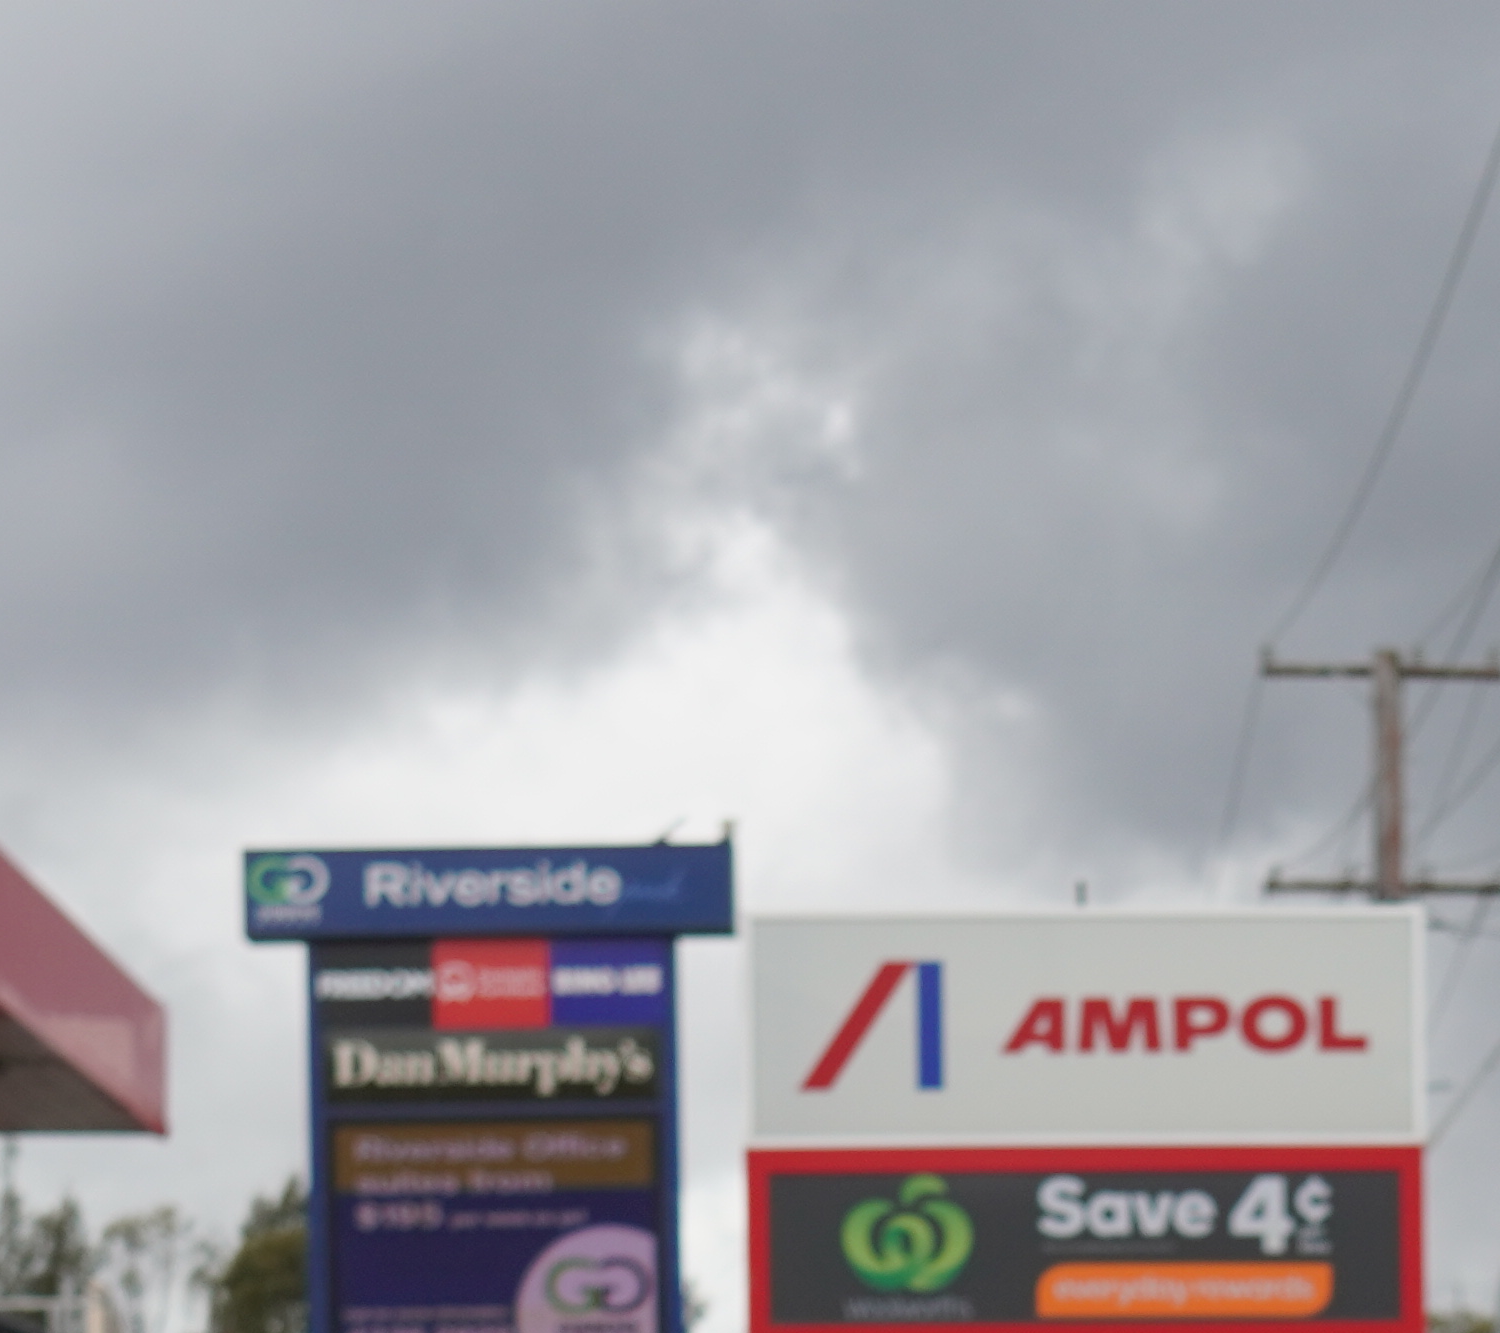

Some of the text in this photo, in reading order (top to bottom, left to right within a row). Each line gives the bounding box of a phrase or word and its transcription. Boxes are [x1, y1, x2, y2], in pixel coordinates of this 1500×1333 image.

[362, 858, 623, 907] Riverside
[1003, 995, 1370, 1054] AMPOL
[332, 1033, 655, 1097] Dan Murphy's
[1036, 1173, 1218, 1238] Save
